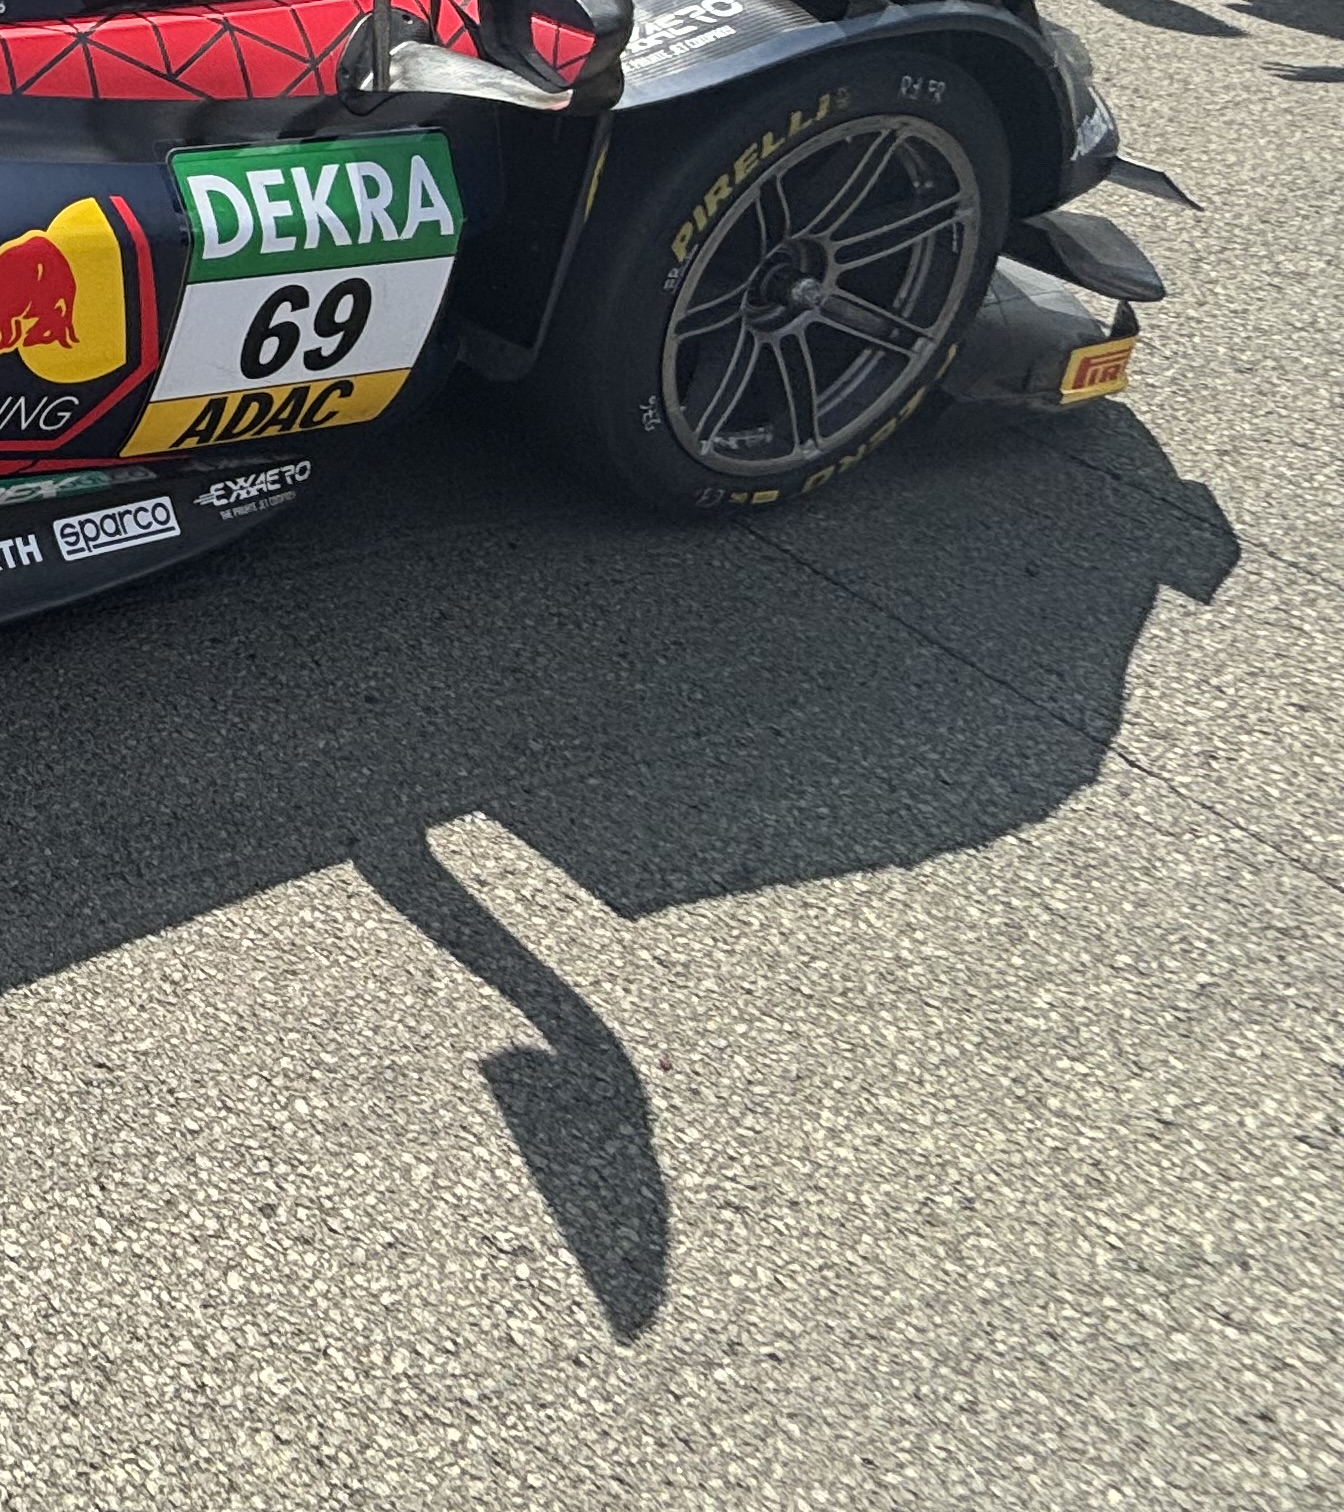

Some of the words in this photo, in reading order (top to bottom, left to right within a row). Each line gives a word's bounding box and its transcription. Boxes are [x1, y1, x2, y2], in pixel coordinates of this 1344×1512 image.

[186, 154, 455, 260] DEKRA
[671, 93, 830, 263] PIRELLI
[240, 277, 372, 380] 69
[168, 379, 355, 449] ADAC
[59, 502, 171, 552] sparco
